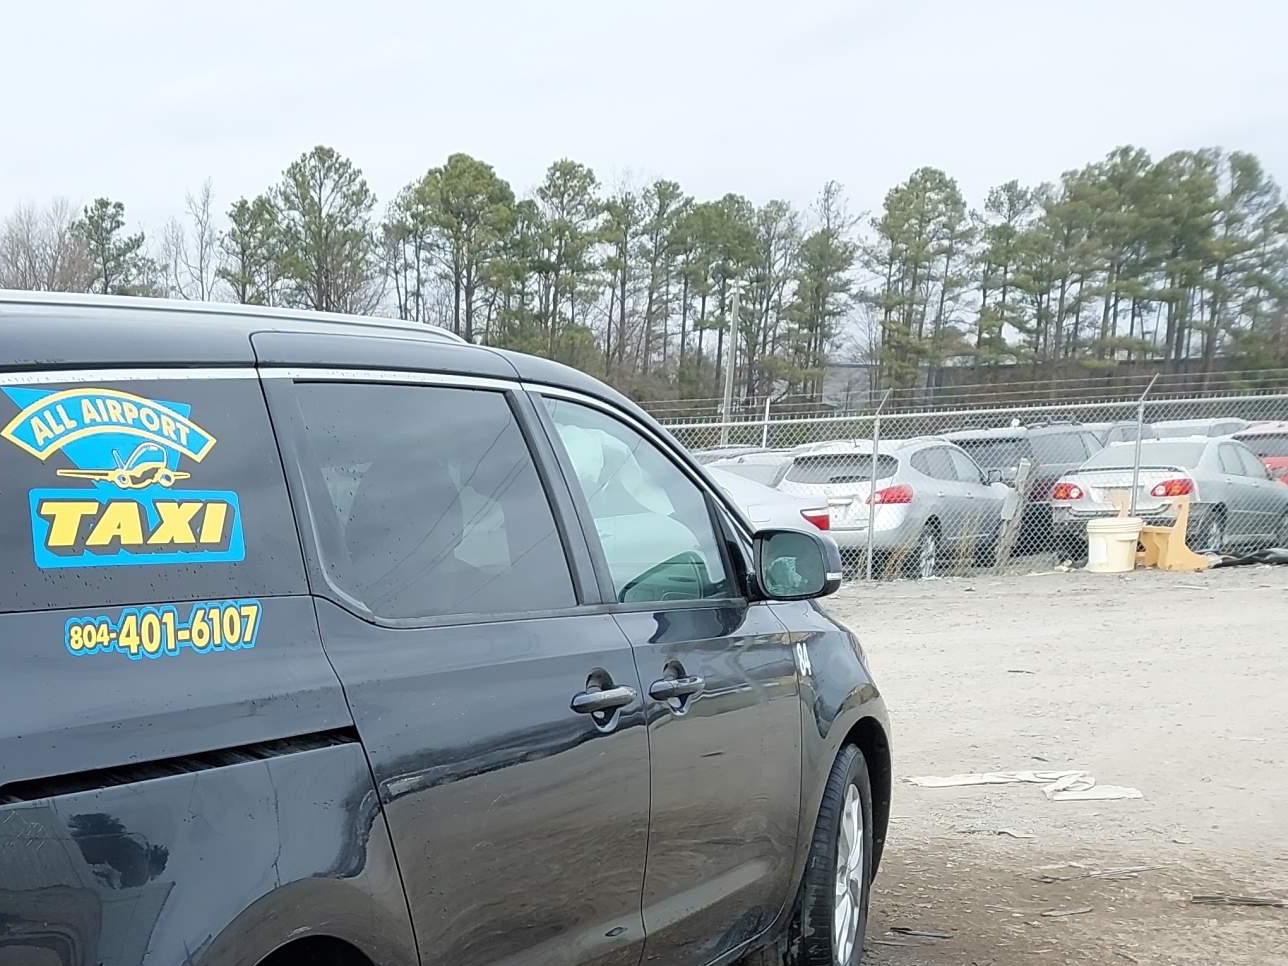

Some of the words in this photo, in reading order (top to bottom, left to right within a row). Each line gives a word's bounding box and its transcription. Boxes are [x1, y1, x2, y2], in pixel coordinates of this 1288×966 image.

[29, 402, 77, 446] ALL
[81, 398, 190, 445] AIRPORT
[40, 501, 228, 547] TAXI
[69, 604, 259, 654] 804-401-6107
[796, 642, 812, 676] 84
